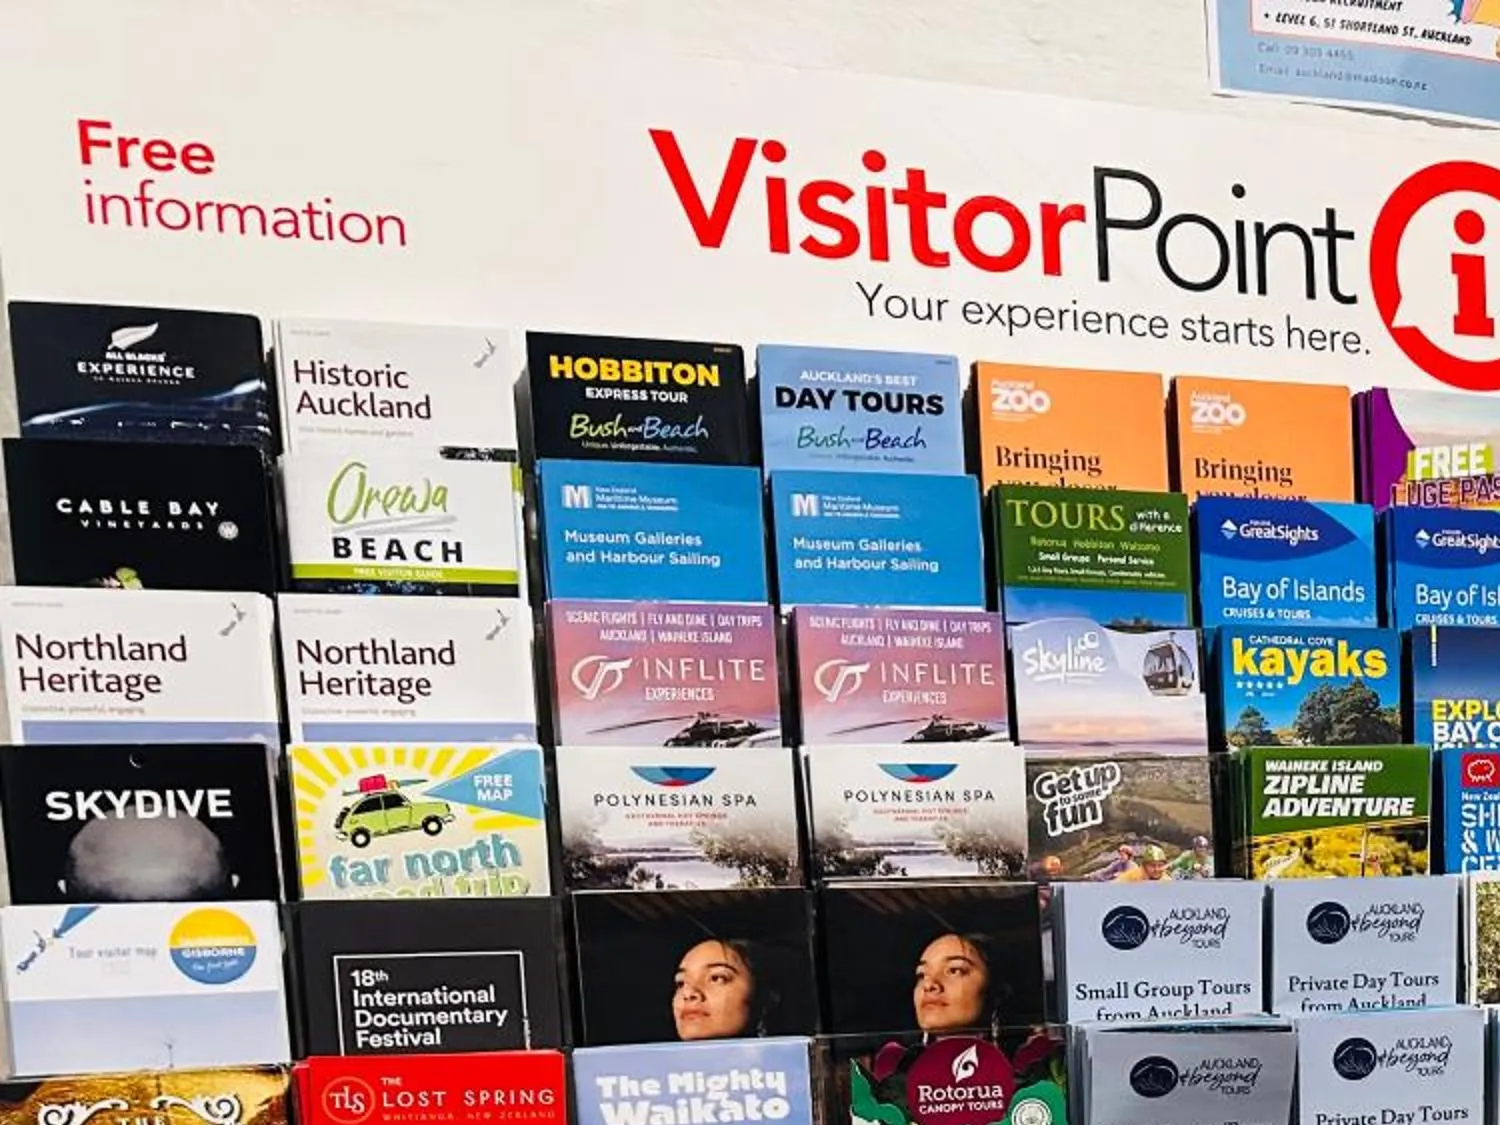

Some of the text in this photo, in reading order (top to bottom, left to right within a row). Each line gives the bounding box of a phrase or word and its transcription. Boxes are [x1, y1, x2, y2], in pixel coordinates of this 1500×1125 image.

[1276, 12, 1305, 25] LEVEL
[1340, 20, 1399, 36] SHORTLAND
[1422, 30, 1472, 46] AUCKLAND
[78, 118, 214, 174] Free
[85, 180, 406, 246] information
[648, 129, 1358, 304] VisitorPoint
[856, 282, 1371, 355] Your experience starts here.
[77, 361, 195, 378] EXPERIENCE
[294, 360, 408, 389] Historic
[550, 355, 720, 386] HOBBITON
[297, 390, 431, 419] Auckland
[586, 387, 688, 403] EXPRESS TOUR
[775, 386, 944, 416] DAY TOURS
[797, 426, 927, 450] Bush Beach
[997, 446, 1102, 477] Bringing
[1195, 457, 1292, 487] Bringing
[1414, 442, 1486, 480] FREE
[327, 461, 449, 524] Orewa
[57, 498, 219, 516] CABLE BAY
[1007, 500, 1125, 531] TOURS
[81, 519, 203, 530] VINEYARDS
[1240, 523, 1319, 546] GreatSights
[333, 537, 463, 562] BEACH
[564, 530, 702, 547] Museum Galleries
[793, 537, 922, 552] Museum Galleries
[566, 551, 720, 568] and Harbour Sailing
[794, 558, 939, 573] and Harbour Sailing
[1223, 576, 1364, 604] Bay of Islands
[1415, 584, 1453, 609] Bay
[1456, 584, 1478, 605] of
[1223, 607, 1311, 619] CRUISES & TOURS
[15, 633, 187, 662] Northland
[297, 639, 456, 666] Northland
[1249, 636, 1335, 646] CATHEDRAL COVE
[642, 658, 765, 681] INFLITE
[1232, 638, 1387, 684] kayaks
[19, 666, 162, 701] Heritage
[881, 662, 994, 685] INFLITE
[300, 670, 432, 703] Heritage
[645, 687, 713, 700] EXPERIENCES
[1433, 721, 1482, 742] BAY
[474, 774, 512, 787] FREE
[1035, 762, 1118, 796] Get up
[1264, 775, 1365, 795] ZIPLINE
[46, 789, 233, 820] SKYDIVE
[477, 789, 513, 801] MAP
[594, 793, 756, 807] POLYNESIAN SPA
[844, 790, 994, 802] POLYNESIAN SPA
[1462, 792, 1481, 800] New
[1046, 801, 1100, 833] fun
[1262, 798, 1415, 817] ADVENTURE
[1462, 829, 1478, 853] &
[330, 834, 521, 888] far north
[351, 969, 388, 986] 18th
[1289, 972, 1439, 993] Private Day Tours
[353, 984, 495, 1007] International
[1076, 980, 1251, 1003] Small Group Tours
[355, 1008, 507, 1028] Documentary
[357, 1028, 441, 1048] Festival
[596, 1069, 787, 1100] The Mighty
[919, 1084, 1003, 1101] Rotorua
[383, 1089, 554, 1107] LOST SPRING
[919, 1100, 1003, 1114] CANOPY TOURS
[1418, 1106, 1468, 1122] Tours
